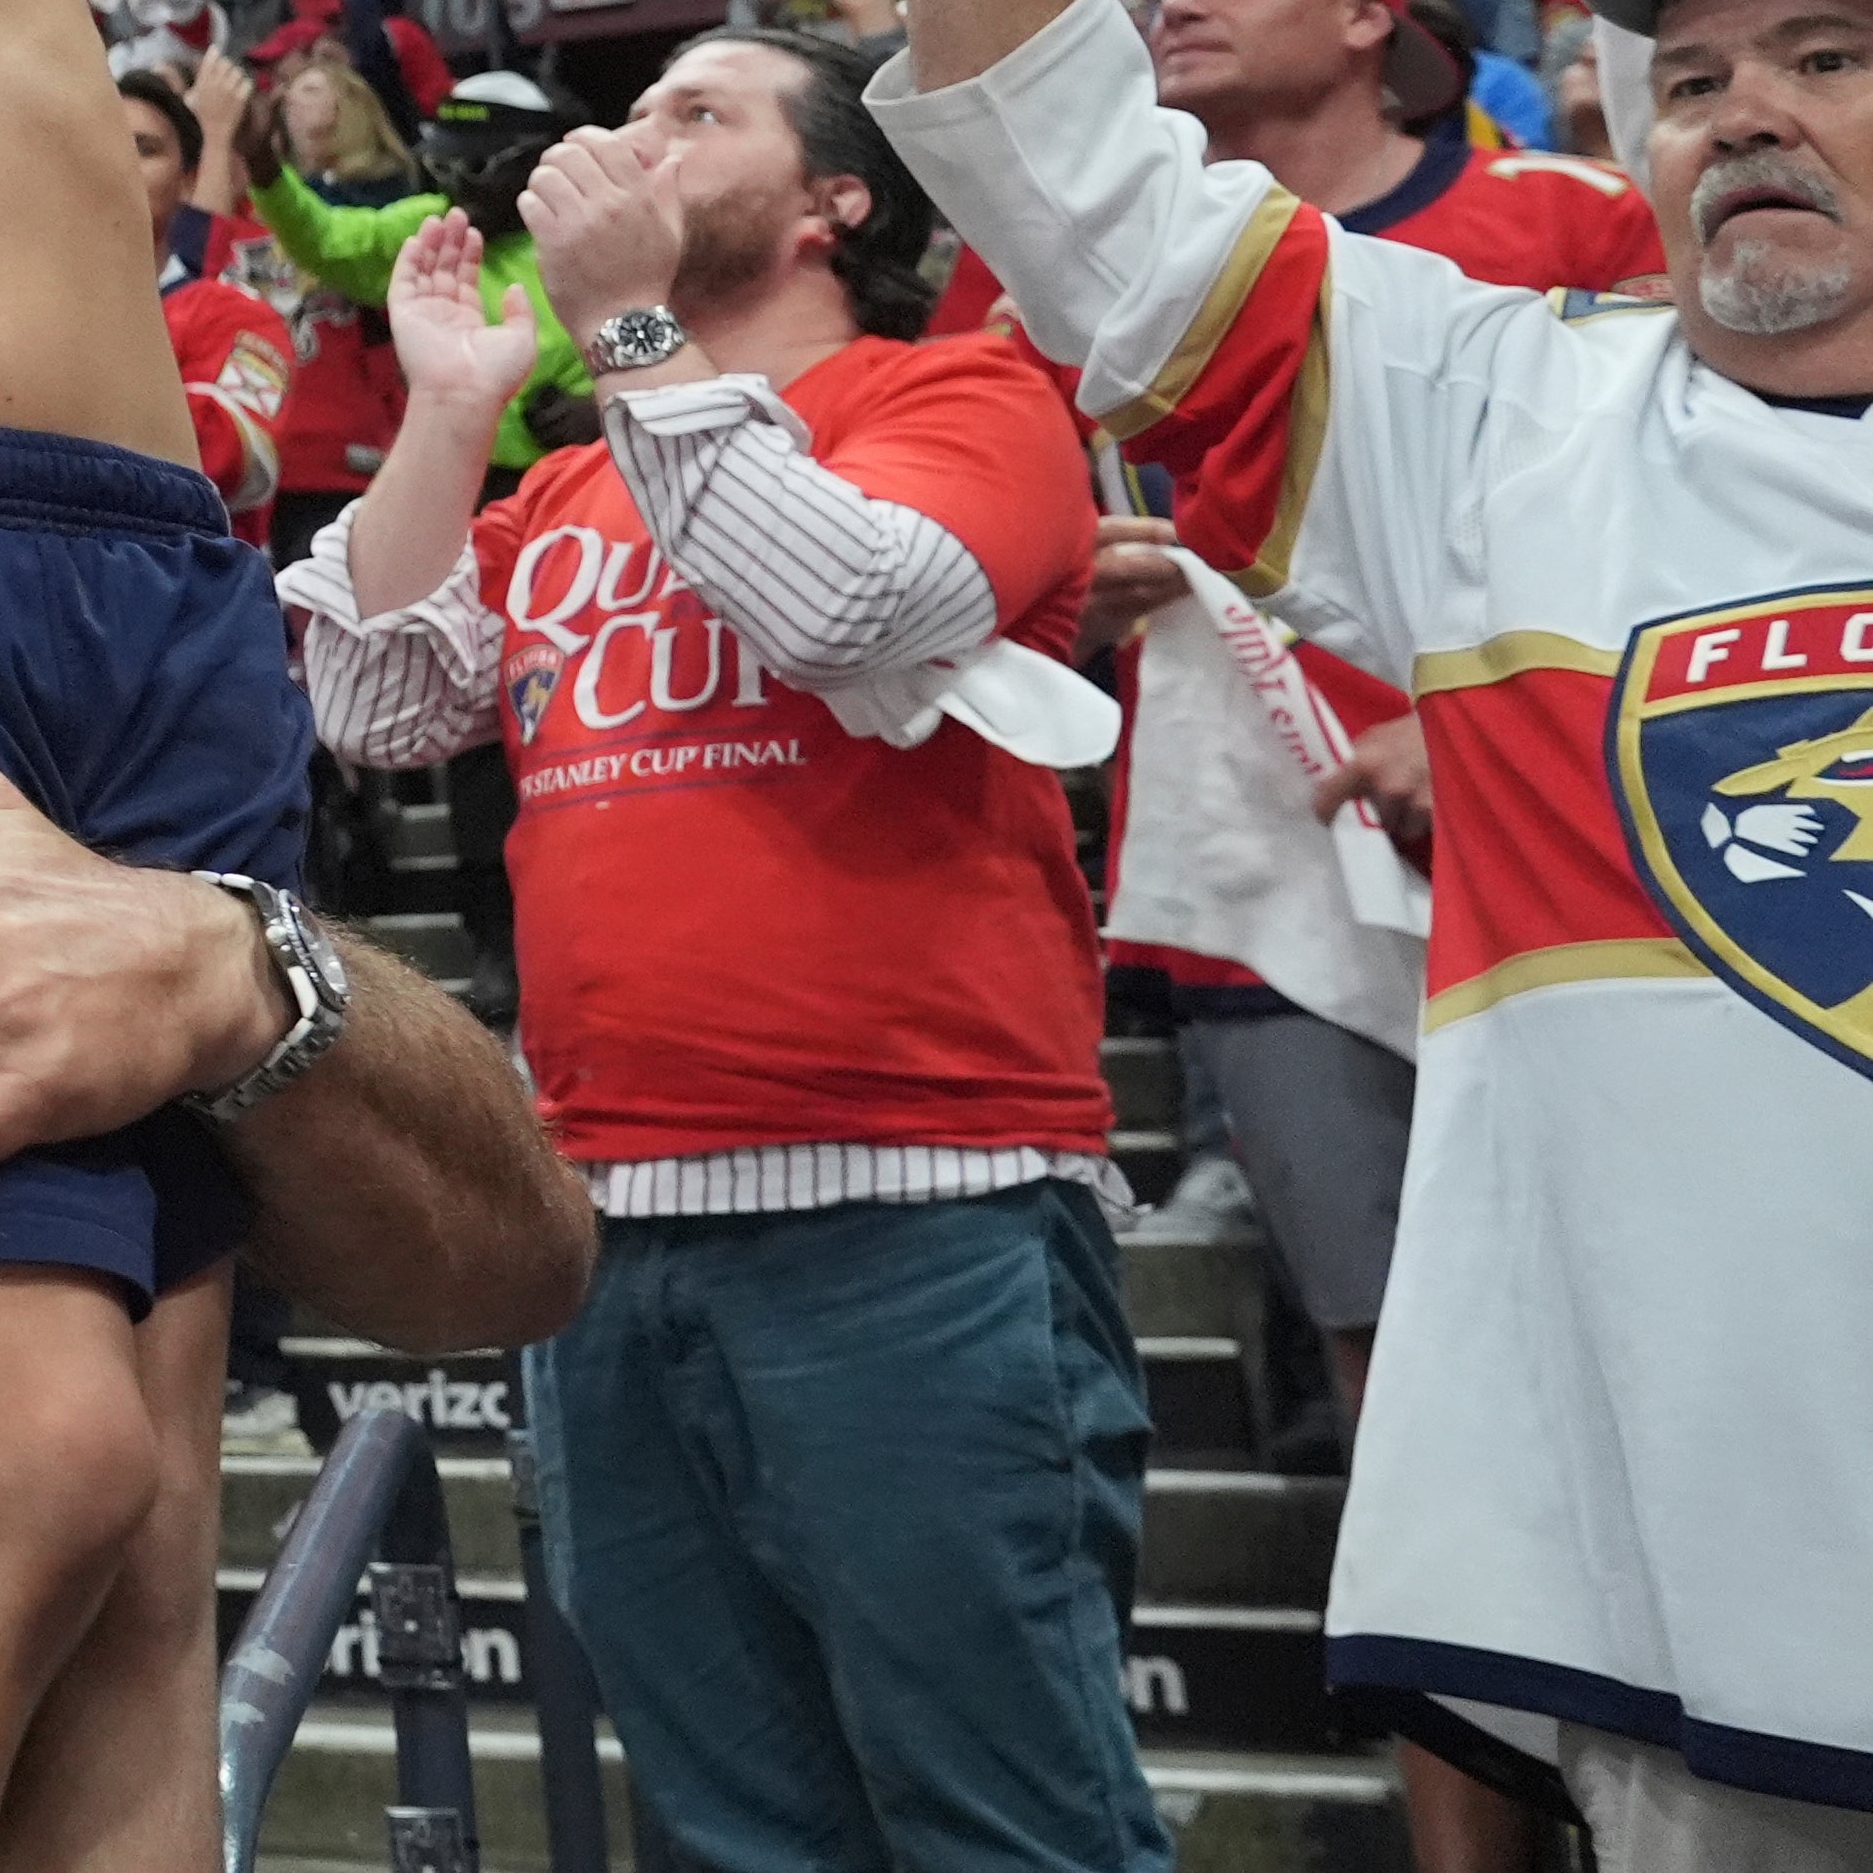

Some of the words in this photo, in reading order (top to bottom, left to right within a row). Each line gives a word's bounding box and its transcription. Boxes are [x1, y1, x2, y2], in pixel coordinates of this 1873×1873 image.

[533, 752, 629, 795] STANLEY
[630, 744, 700, 777] CUP
[703, 738, 808, 770] FINAL
